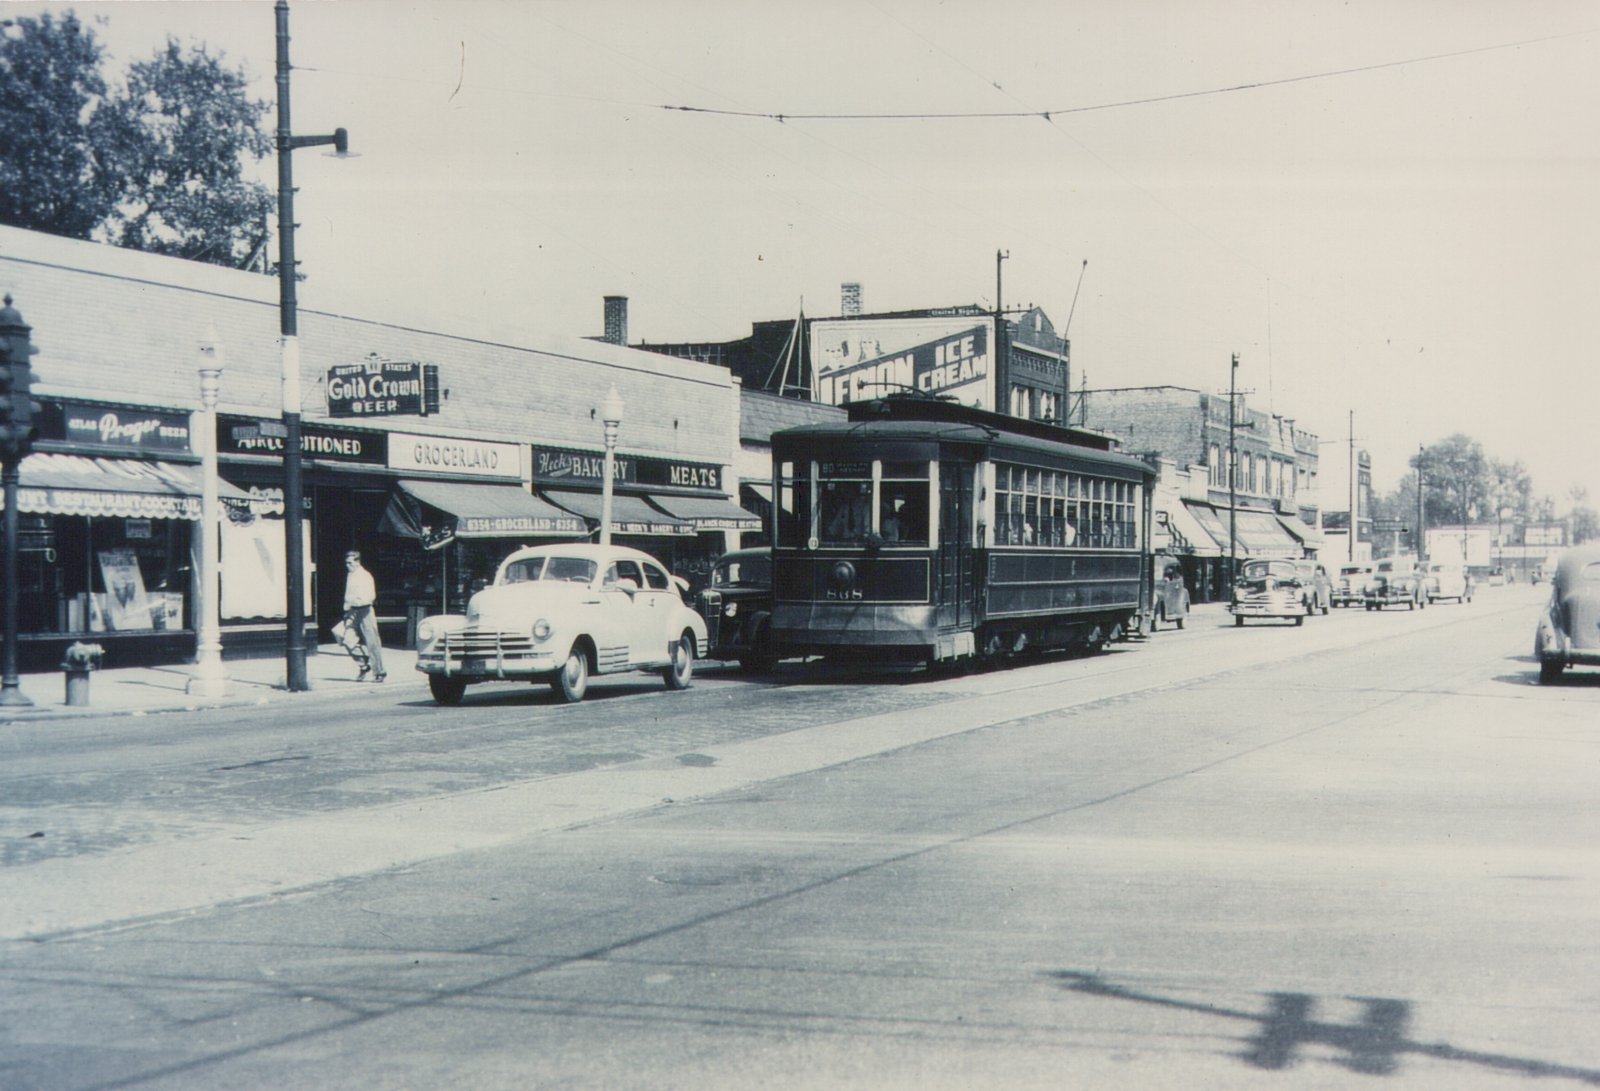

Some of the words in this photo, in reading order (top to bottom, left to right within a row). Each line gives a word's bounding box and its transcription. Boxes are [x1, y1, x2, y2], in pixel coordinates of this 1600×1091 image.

[935, 335, 975, 367] ICE
[385, 363, 412, 372] STATES
[918, 353, 987, 391] CREAM
[328, 377, 366, 400] Gold
[368, 375, 420, 398] Crown
[352, 400, 398, 413] BEER
[98, 413, 161, 442] Prager
[159, 426, 188, 438] BEER
[538, 452, 572, 474] Heck's
[572, 457, 628, 480] BAKRY
[670, 465, 717, 487] MEATS
[495, 518, 551, 531] GROCERLAND
